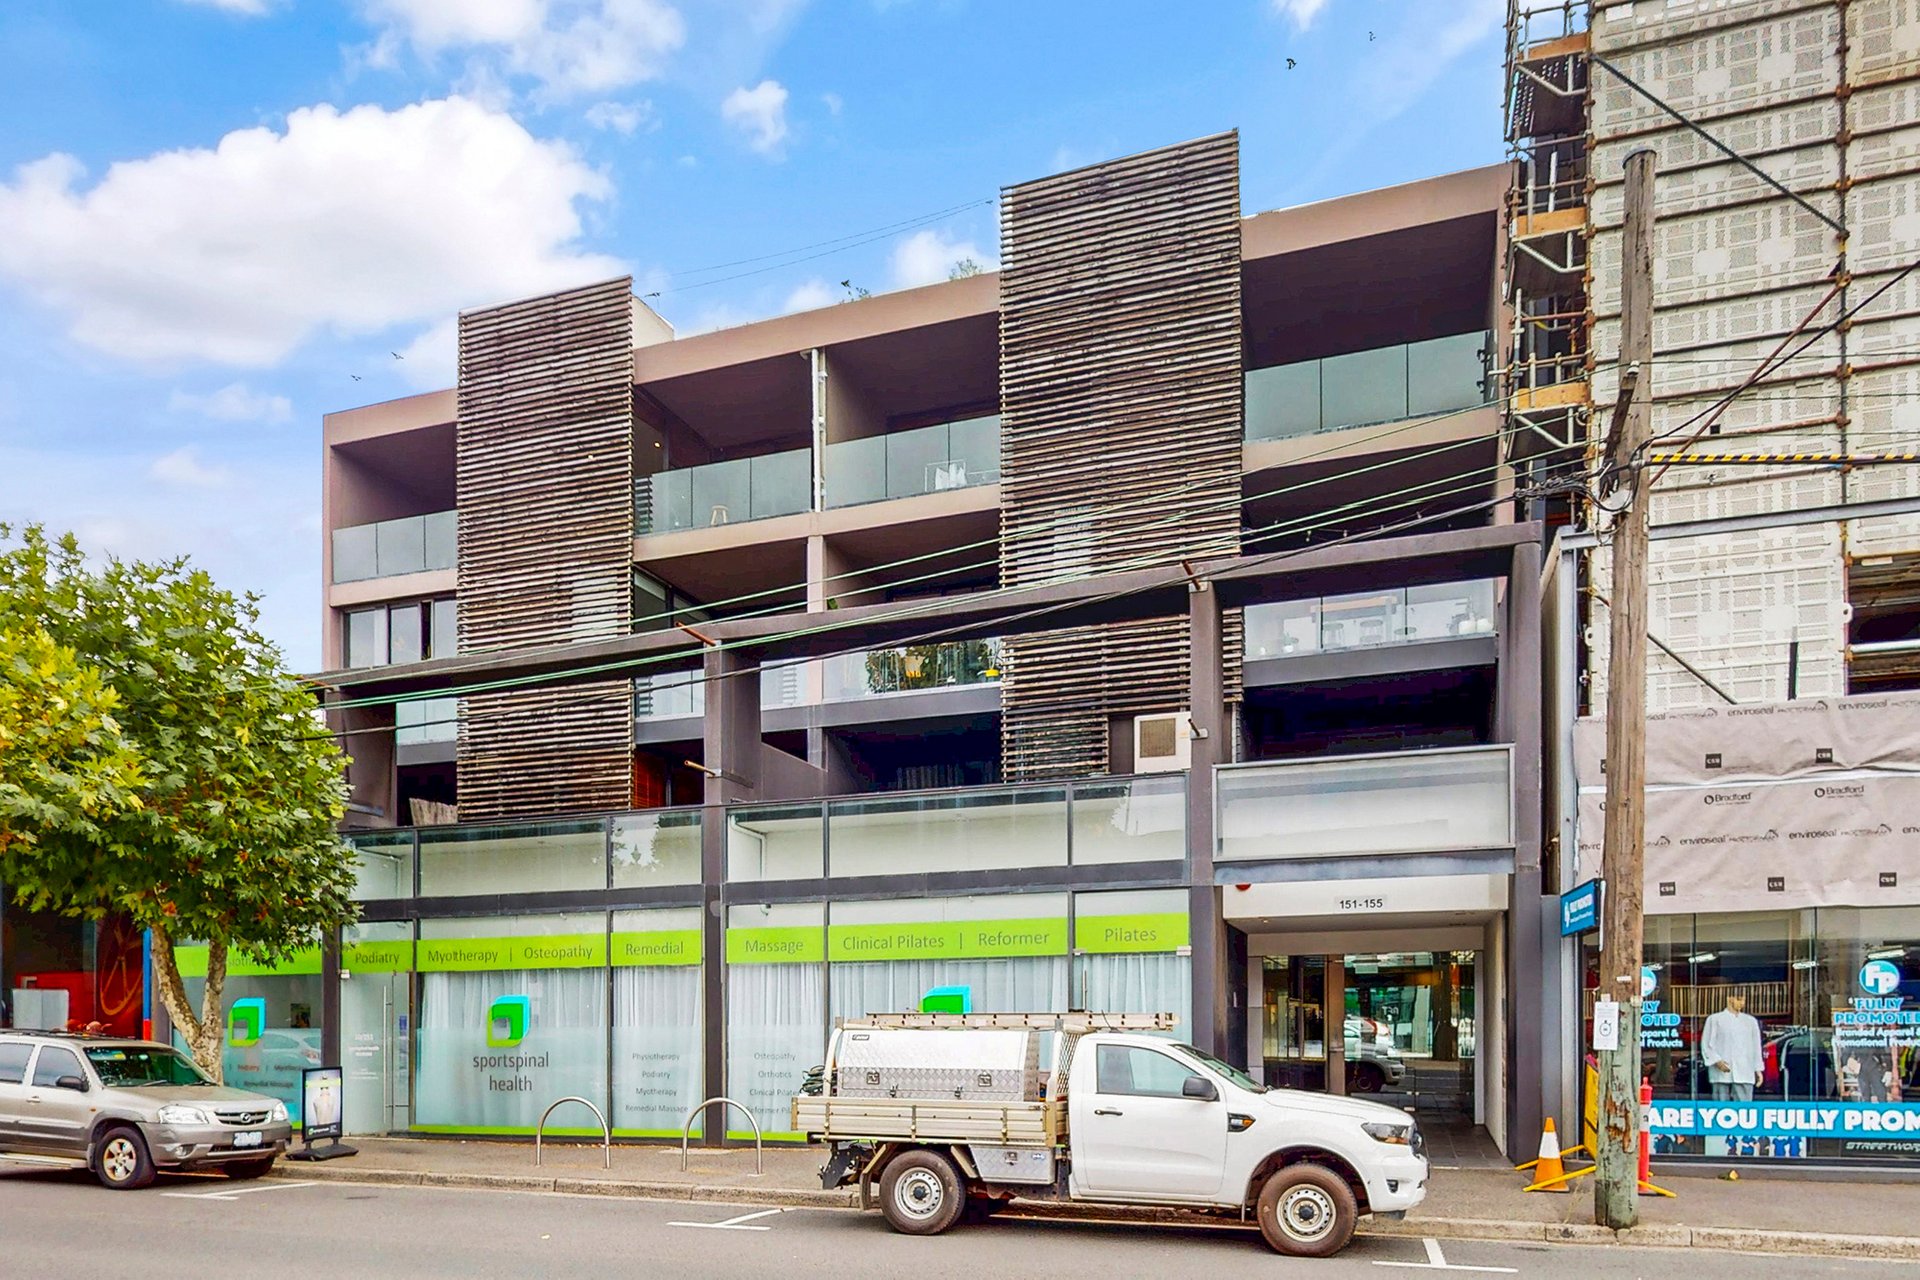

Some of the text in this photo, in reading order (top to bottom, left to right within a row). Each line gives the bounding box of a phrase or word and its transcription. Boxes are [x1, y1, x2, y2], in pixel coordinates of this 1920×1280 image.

[1339, 898, 1383, 909] 151-155
[843, 931, 1050, 950] Clinical Pilates Reformer
[1104, 927, 1157, 942] Pilates
[625, 939, 804, 956] Remedial Massage
[355, 951, 400, 965] Podiatry
[428, 945, 593, 963] Myotherapy Osteopathy
[1854, 997, 1904, 1011] FULLY
[1647, 1039, 1684, 1048] Products
[472, 1051, 549, 1072] sportspinal
[632, 1052, 681, 1062] Physiotherapy
[753, 1052, 796, 1062] Osteopathy
[642, 1070, 671, 1080] Podiatry
[758, 1070, 792, 1079] Orthotics
[489, 1075, 533, 1091] health
[635, 1087, 677, 1097] Myotherapy
[749, 1088, 775, 1096] Clinical
[625, 1104, 657, 1112] Remedial
[1649, 1107, 1695, 1128] ARE
[1698, 1107, 1758, 1129] YOU
[1763, 1108, 1840, 1131] FULLY
